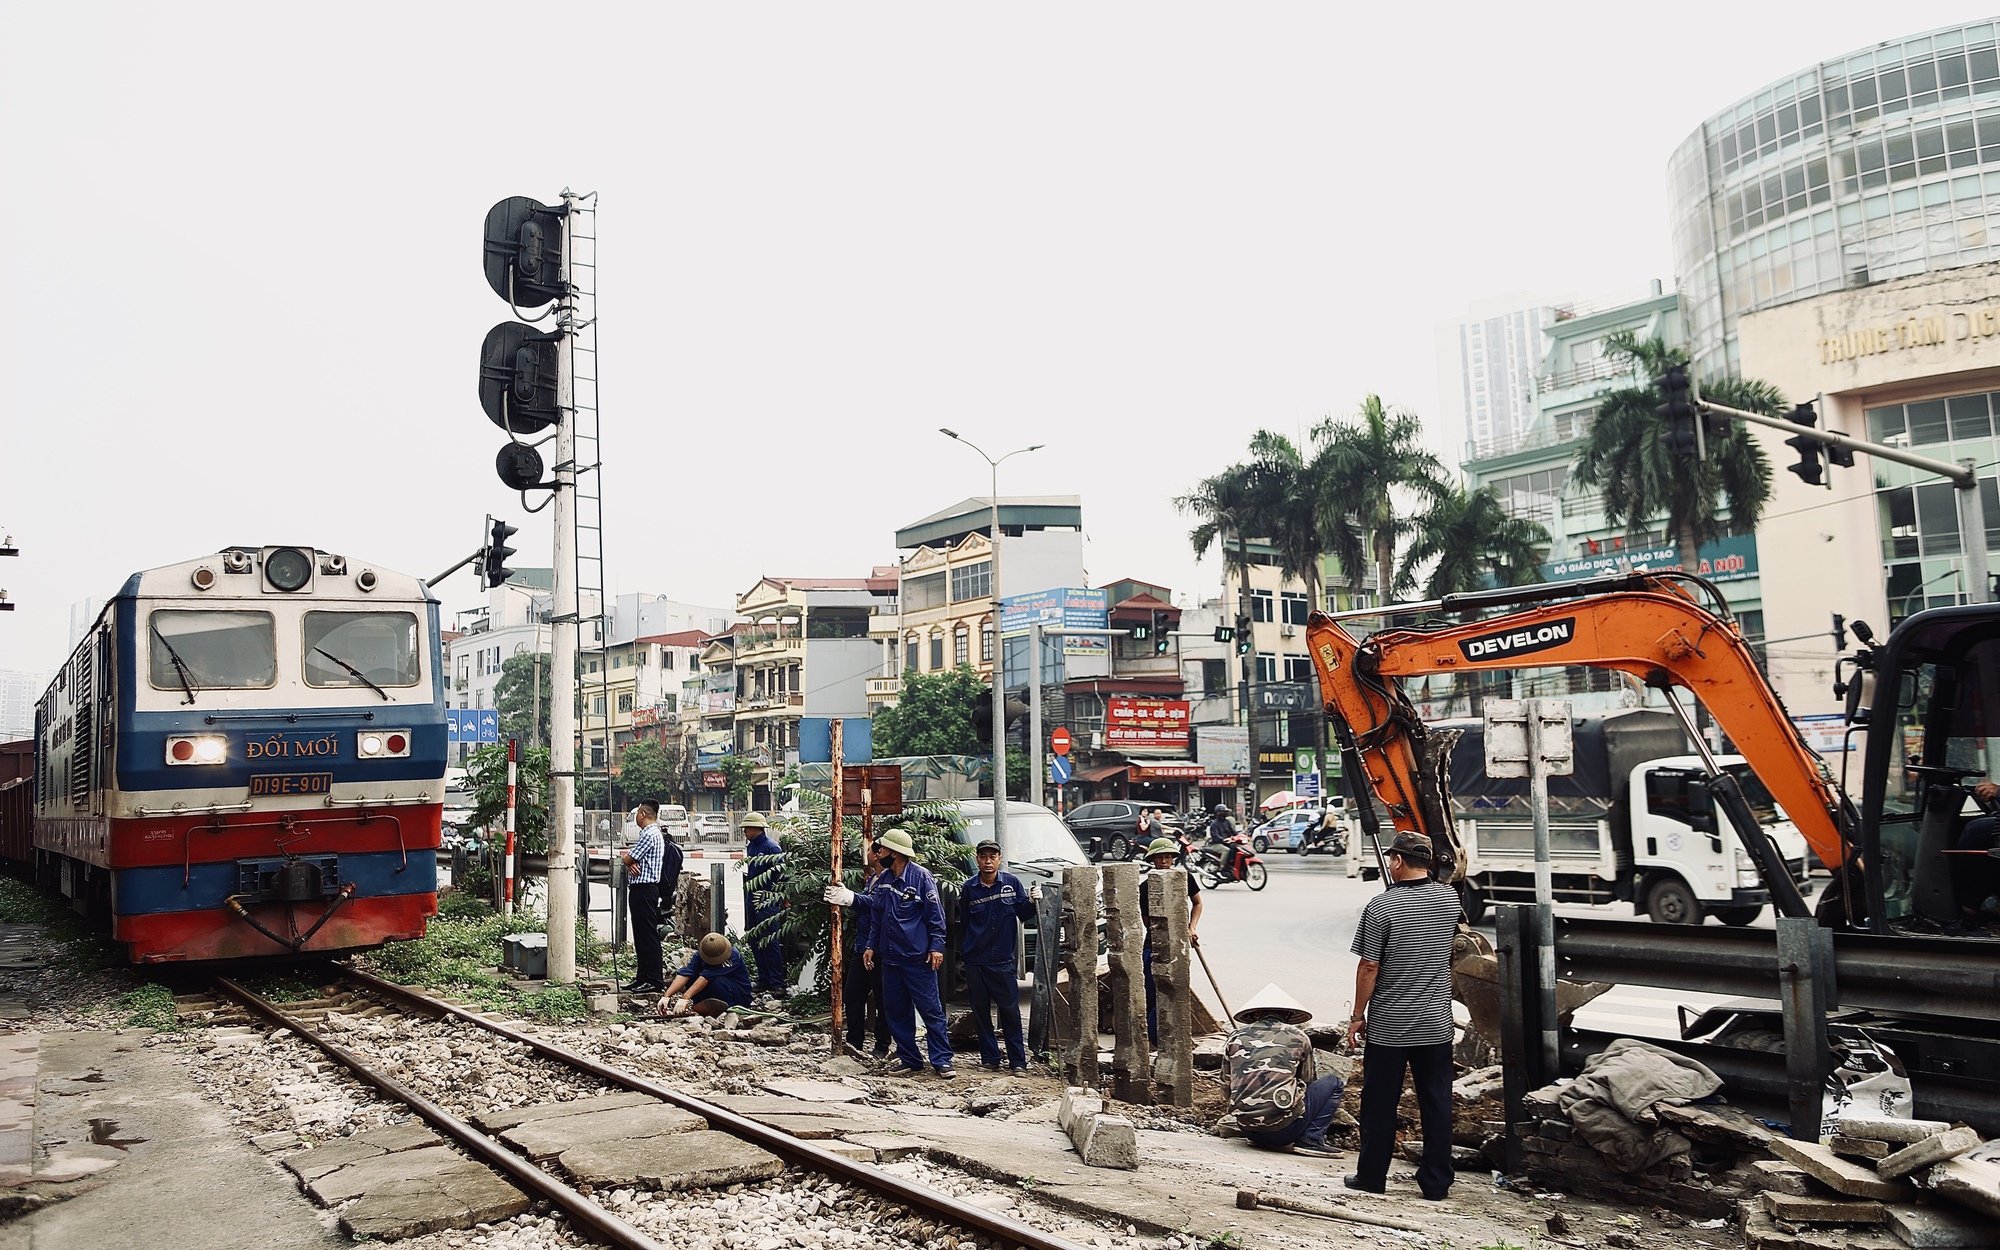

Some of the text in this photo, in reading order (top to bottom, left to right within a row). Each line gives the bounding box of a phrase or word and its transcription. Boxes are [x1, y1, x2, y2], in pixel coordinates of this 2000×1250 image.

[1817, 327, 1888, 365] TRUNG
[1894, 315, 1945, 350] TÂM
[1553, 563, 1567, 575] BỘ
[1568, 558, 1592, 573] GIÁO
[1594, 556, 1613, 572] DỤC
[1630, 550, 1652, 564] ĐÀO
[1652, 549, 1674, 562] TẠO
[1714, 553, 1745, 573] NỘI
[1468, 624, 1569, 657] DEVELON
[247, 733, 338, 758] ĐỔI MỚI
[1270, 753, 1293, 763] MOBILE
[253, 776, 327, 794] D19E-901
